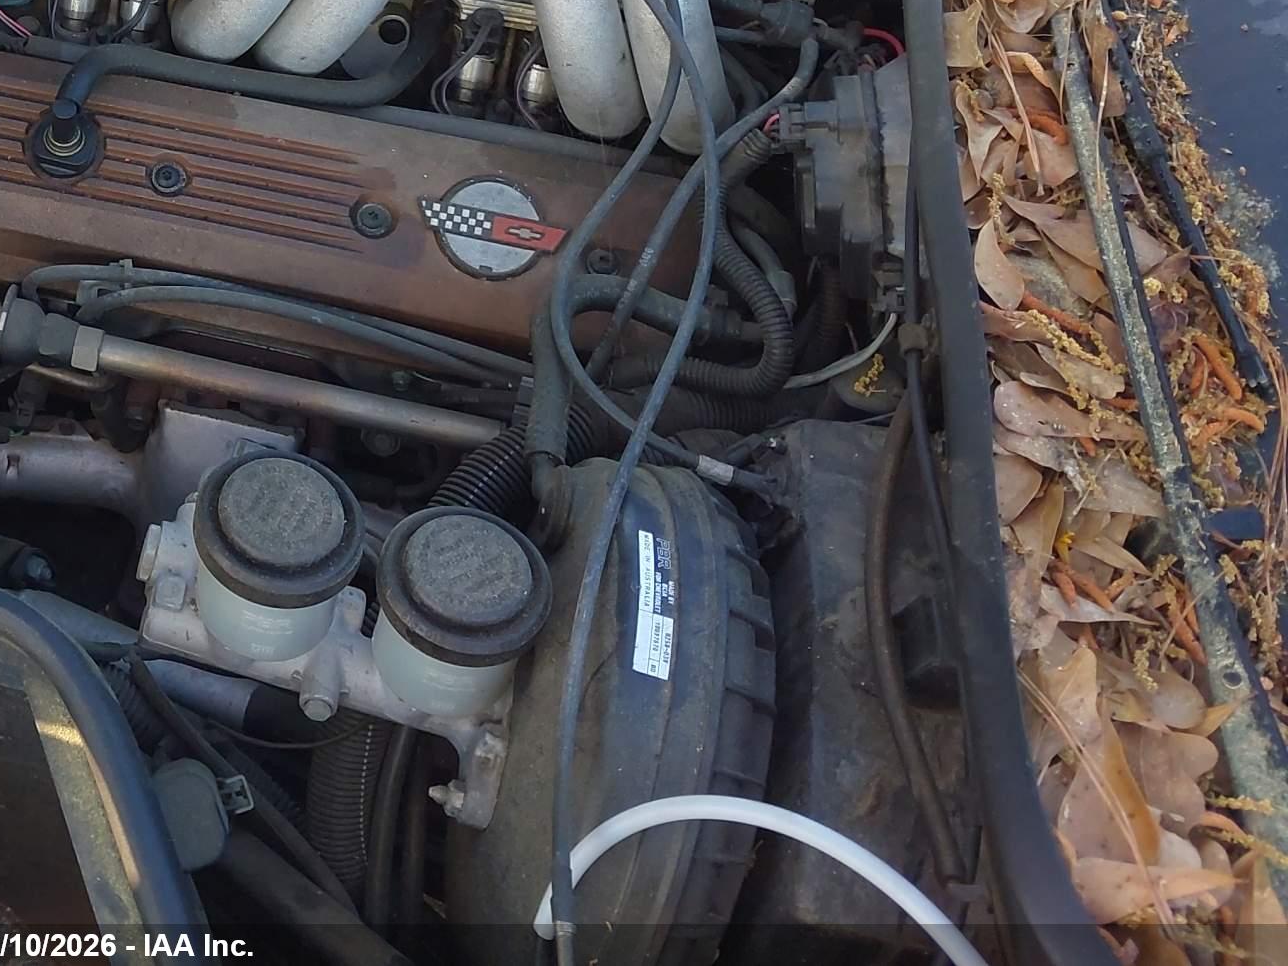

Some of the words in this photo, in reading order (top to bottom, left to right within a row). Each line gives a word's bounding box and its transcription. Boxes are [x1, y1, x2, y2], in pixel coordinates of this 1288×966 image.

[644, 555, 651, 563] IN
[655, 537, 672, 570] PBR
[643, 568, 652, 606] AUSTRALIA
[654, 583, 662, 614] CHEVROLET
